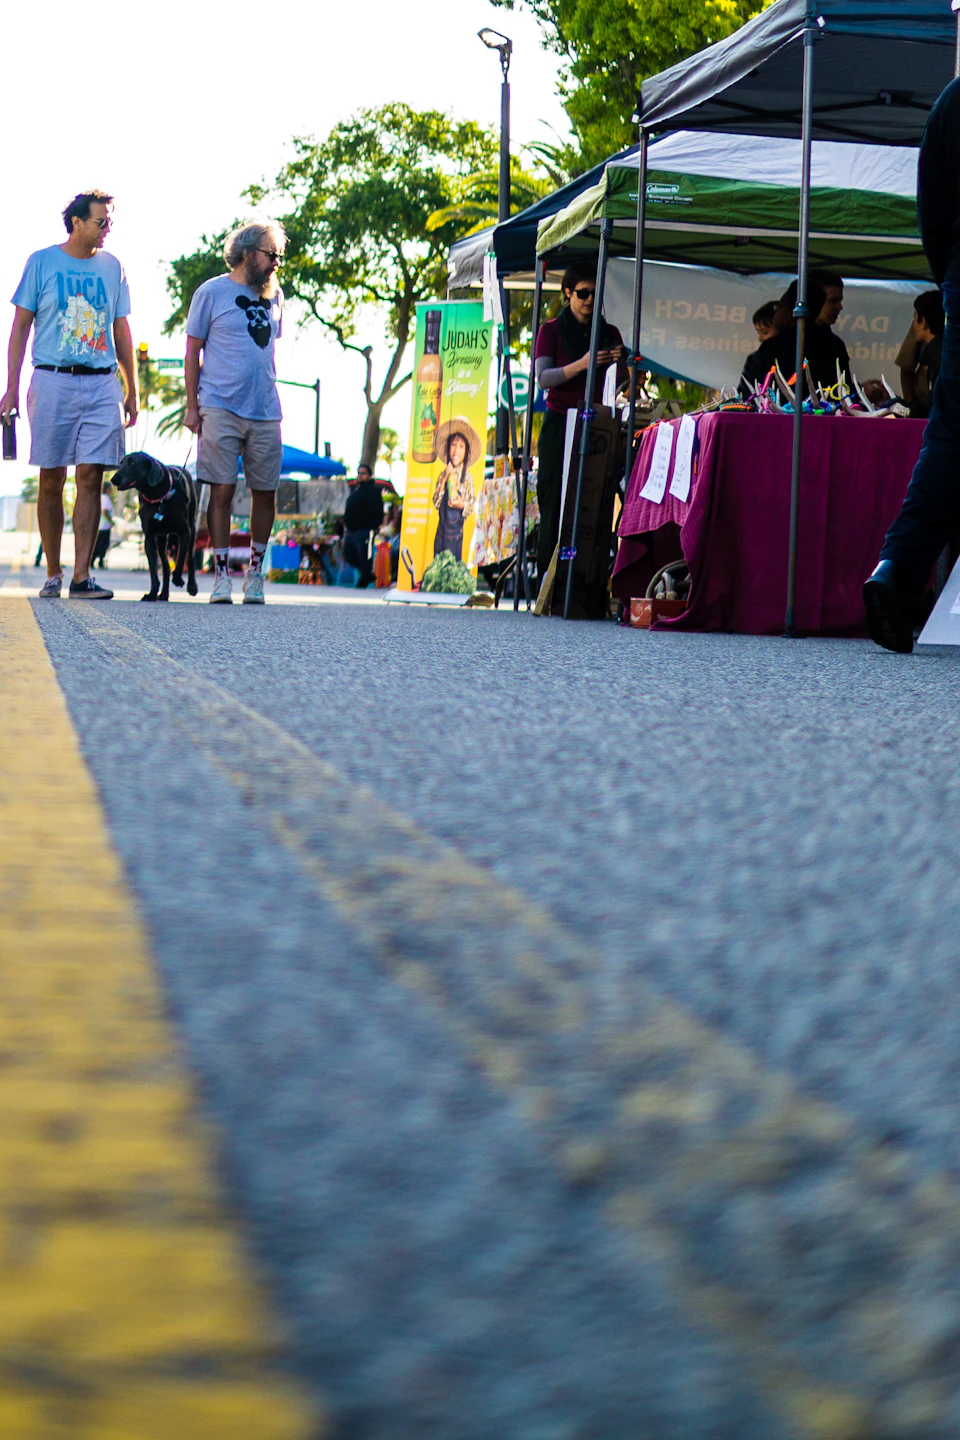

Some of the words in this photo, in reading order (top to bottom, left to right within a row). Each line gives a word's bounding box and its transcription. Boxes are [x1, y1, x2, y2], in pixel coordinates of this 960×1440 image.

[56, 271, 108, 310] LUCA
[442, 329, 489, 352] JUDAH'S
[446, 351, 483, 370] Dressing
[445, 380, 484, 398] Blessing!
[511, 378, 529, 403] P
